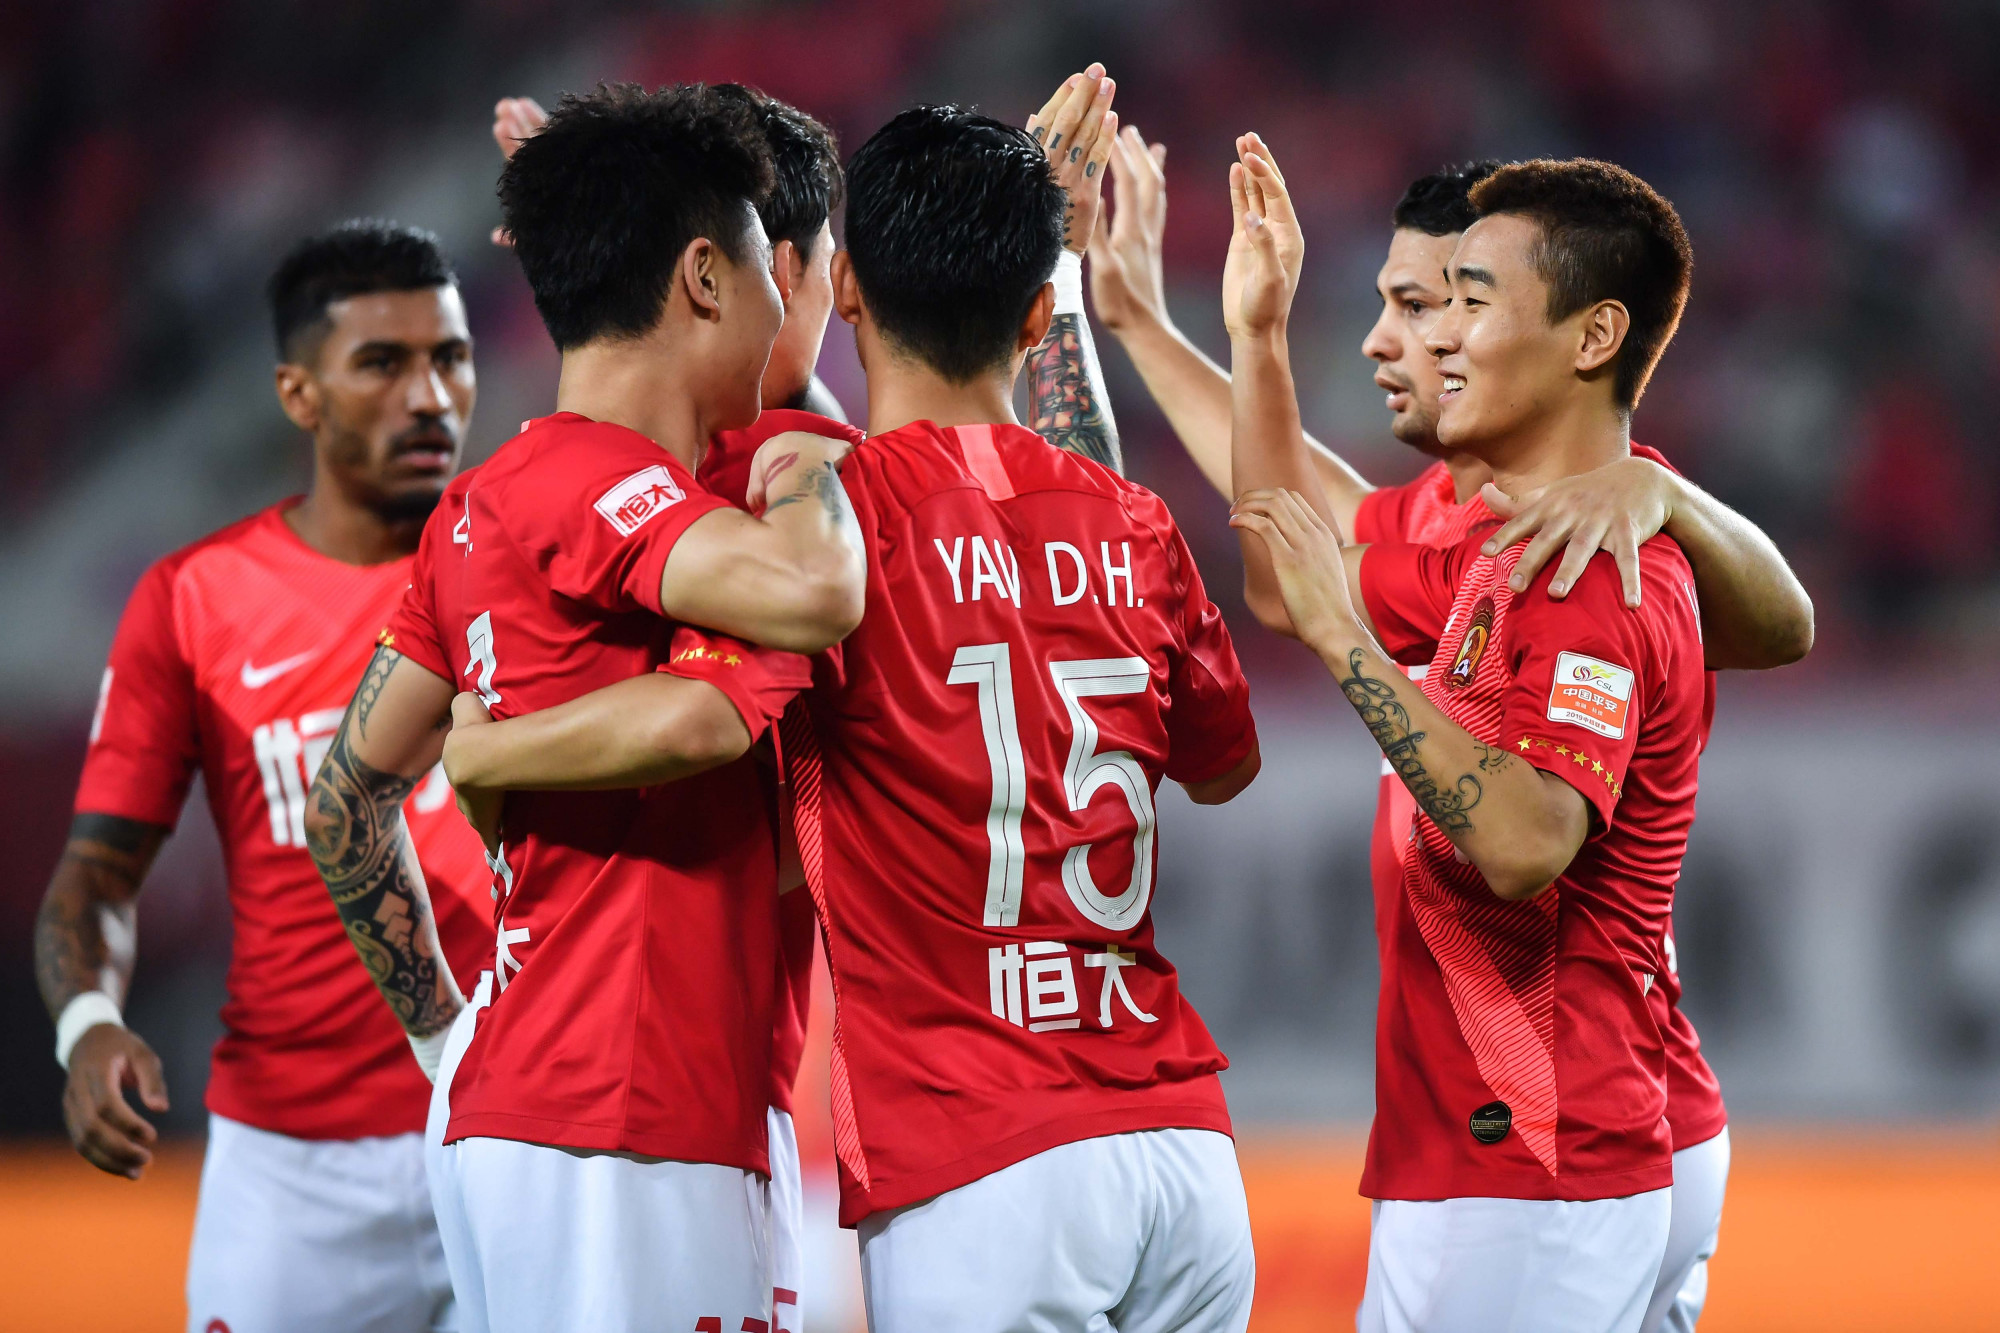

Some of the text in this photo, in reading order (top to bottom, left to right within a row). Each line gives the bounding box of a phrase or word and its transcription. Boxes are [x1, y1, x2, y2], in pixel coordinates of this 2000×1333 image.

[615, 484, 676, 529] 恒大
[1044, 541, 1144, 608] D.H.
[1563, 688, 1618, 712] 中国平安
[1596, 679, 1614, 693] CSL
[946, 642, 1155, 931] 15
[988, 941, 1159, 1033] 恒大
